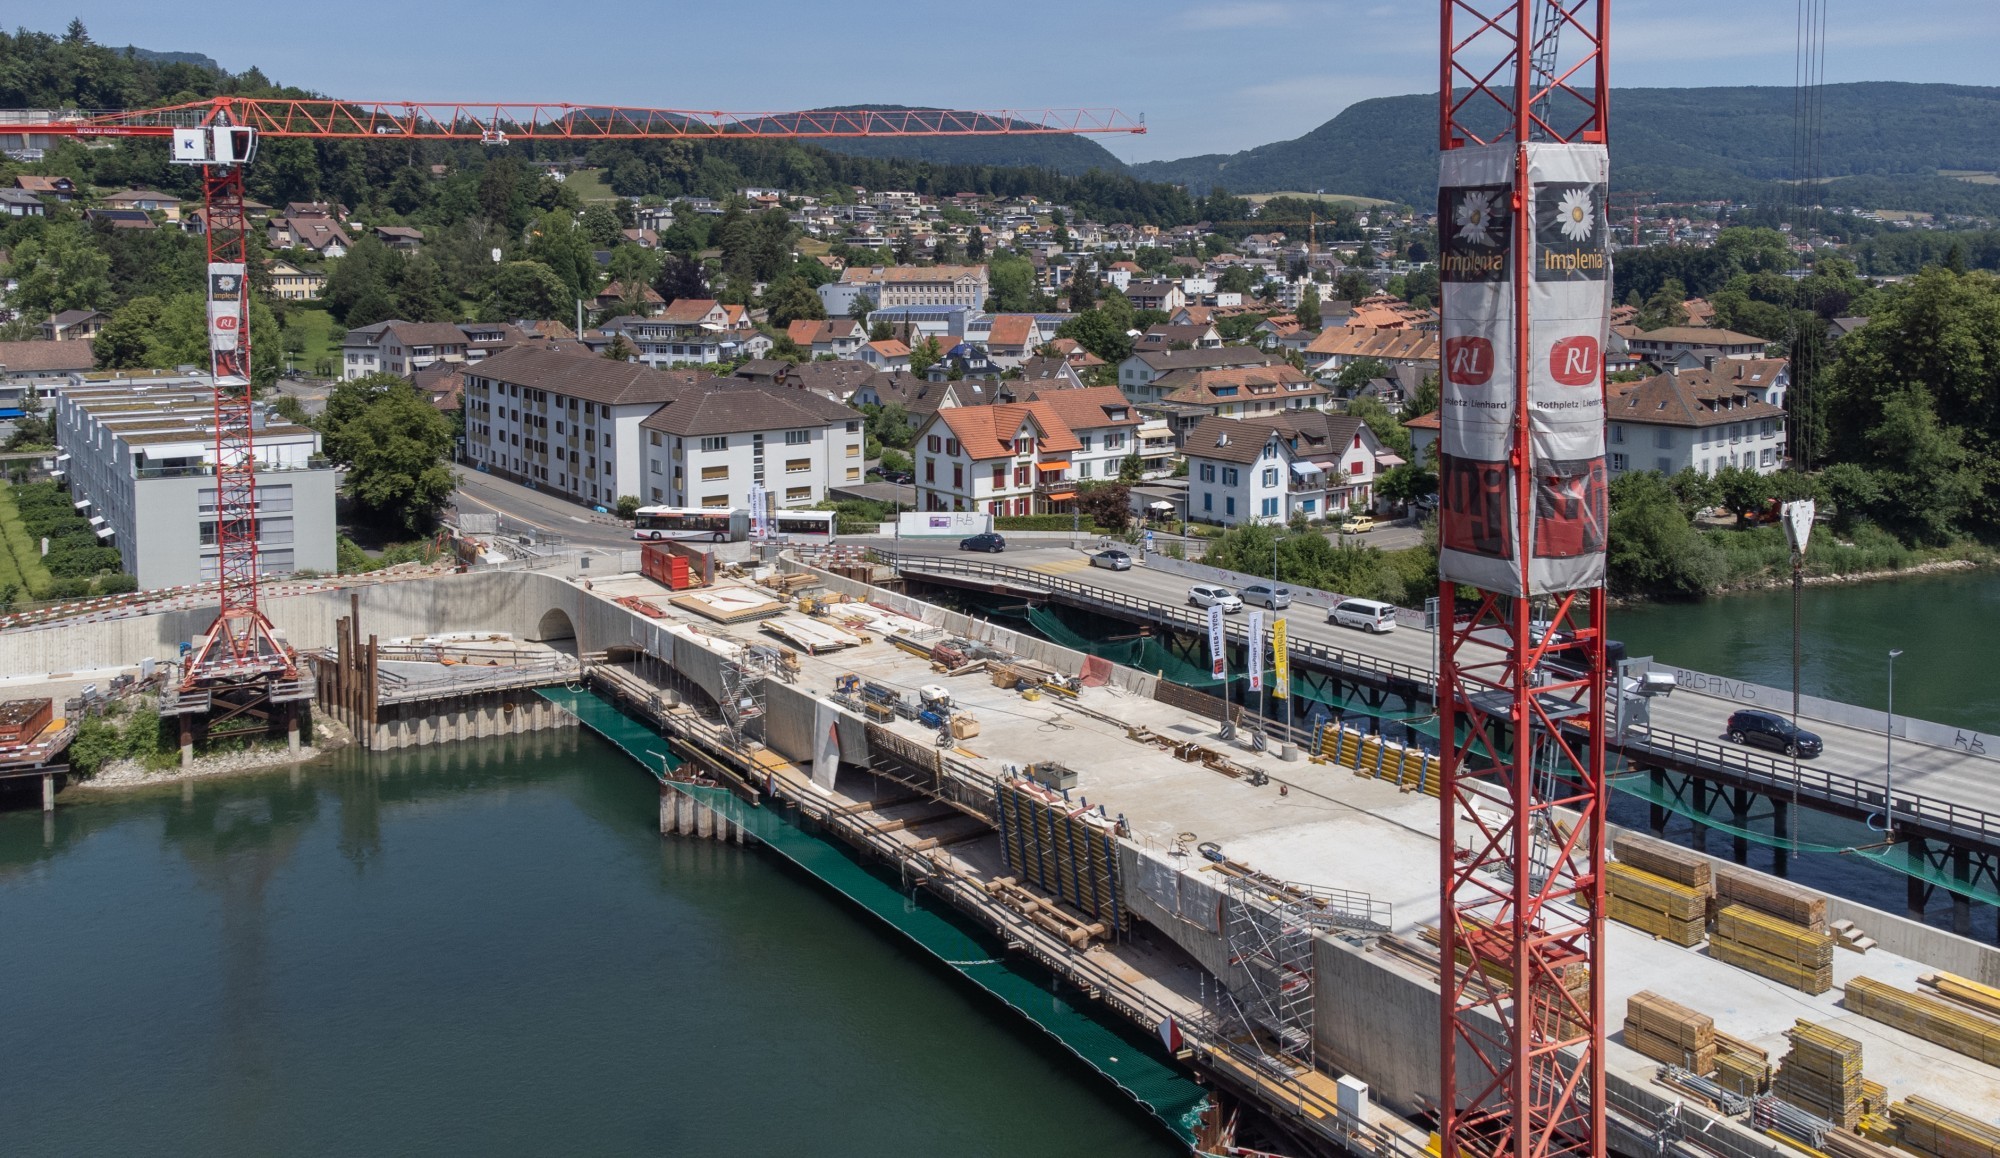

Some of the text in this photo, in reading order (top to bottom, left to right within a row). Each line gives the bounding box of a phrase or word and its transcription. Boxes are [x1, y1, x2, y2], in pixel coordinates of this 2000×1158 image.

[184, 140, 195, 150] K
[1441, 250, 1504, 277] Implenia
[1544, 248, 1604, 275] Implenia
[220, 318, 234, 328] RL
[1452, 346, 1484, 374] RL
[1564, 346, 1592, 375] RL
[1471, 399, 1507, 409] Lienhard
[1536, 400, 1579, 410] Rothpletz
